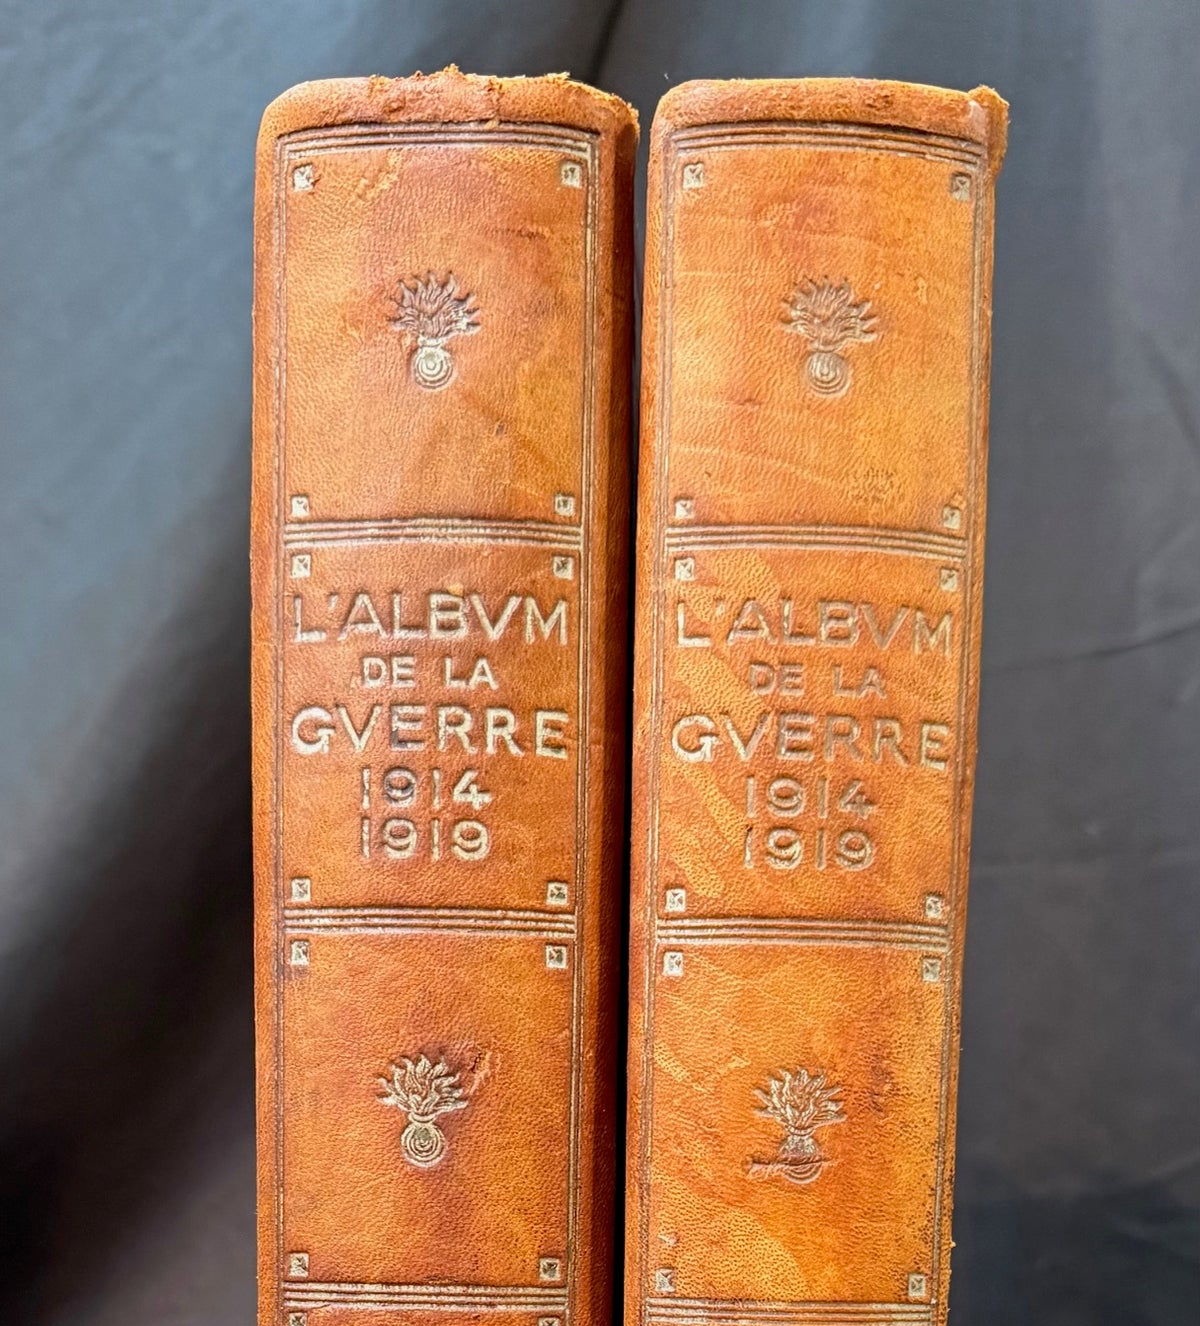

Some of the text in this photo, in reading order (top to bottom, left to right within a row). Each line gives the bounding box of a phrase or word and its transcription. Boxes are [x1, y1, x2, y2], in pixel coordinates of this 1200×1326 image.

[293, 591, 568, 645] L'ALBVM
[676, 598, 954, 657] L'ALBVM
[361, 654, 499, 691] DE LA
[750, 663, 888, 700] DE LA
[291, 703, 570, 760] GVERRE
[671, 711, 950, 771] GVERRE
[361, 766, 494, 811] 1914
[745, 774, 876, 821] 1914
[360, 817, 490, 863] 1919
[743, 826, 875, 872] 1919
